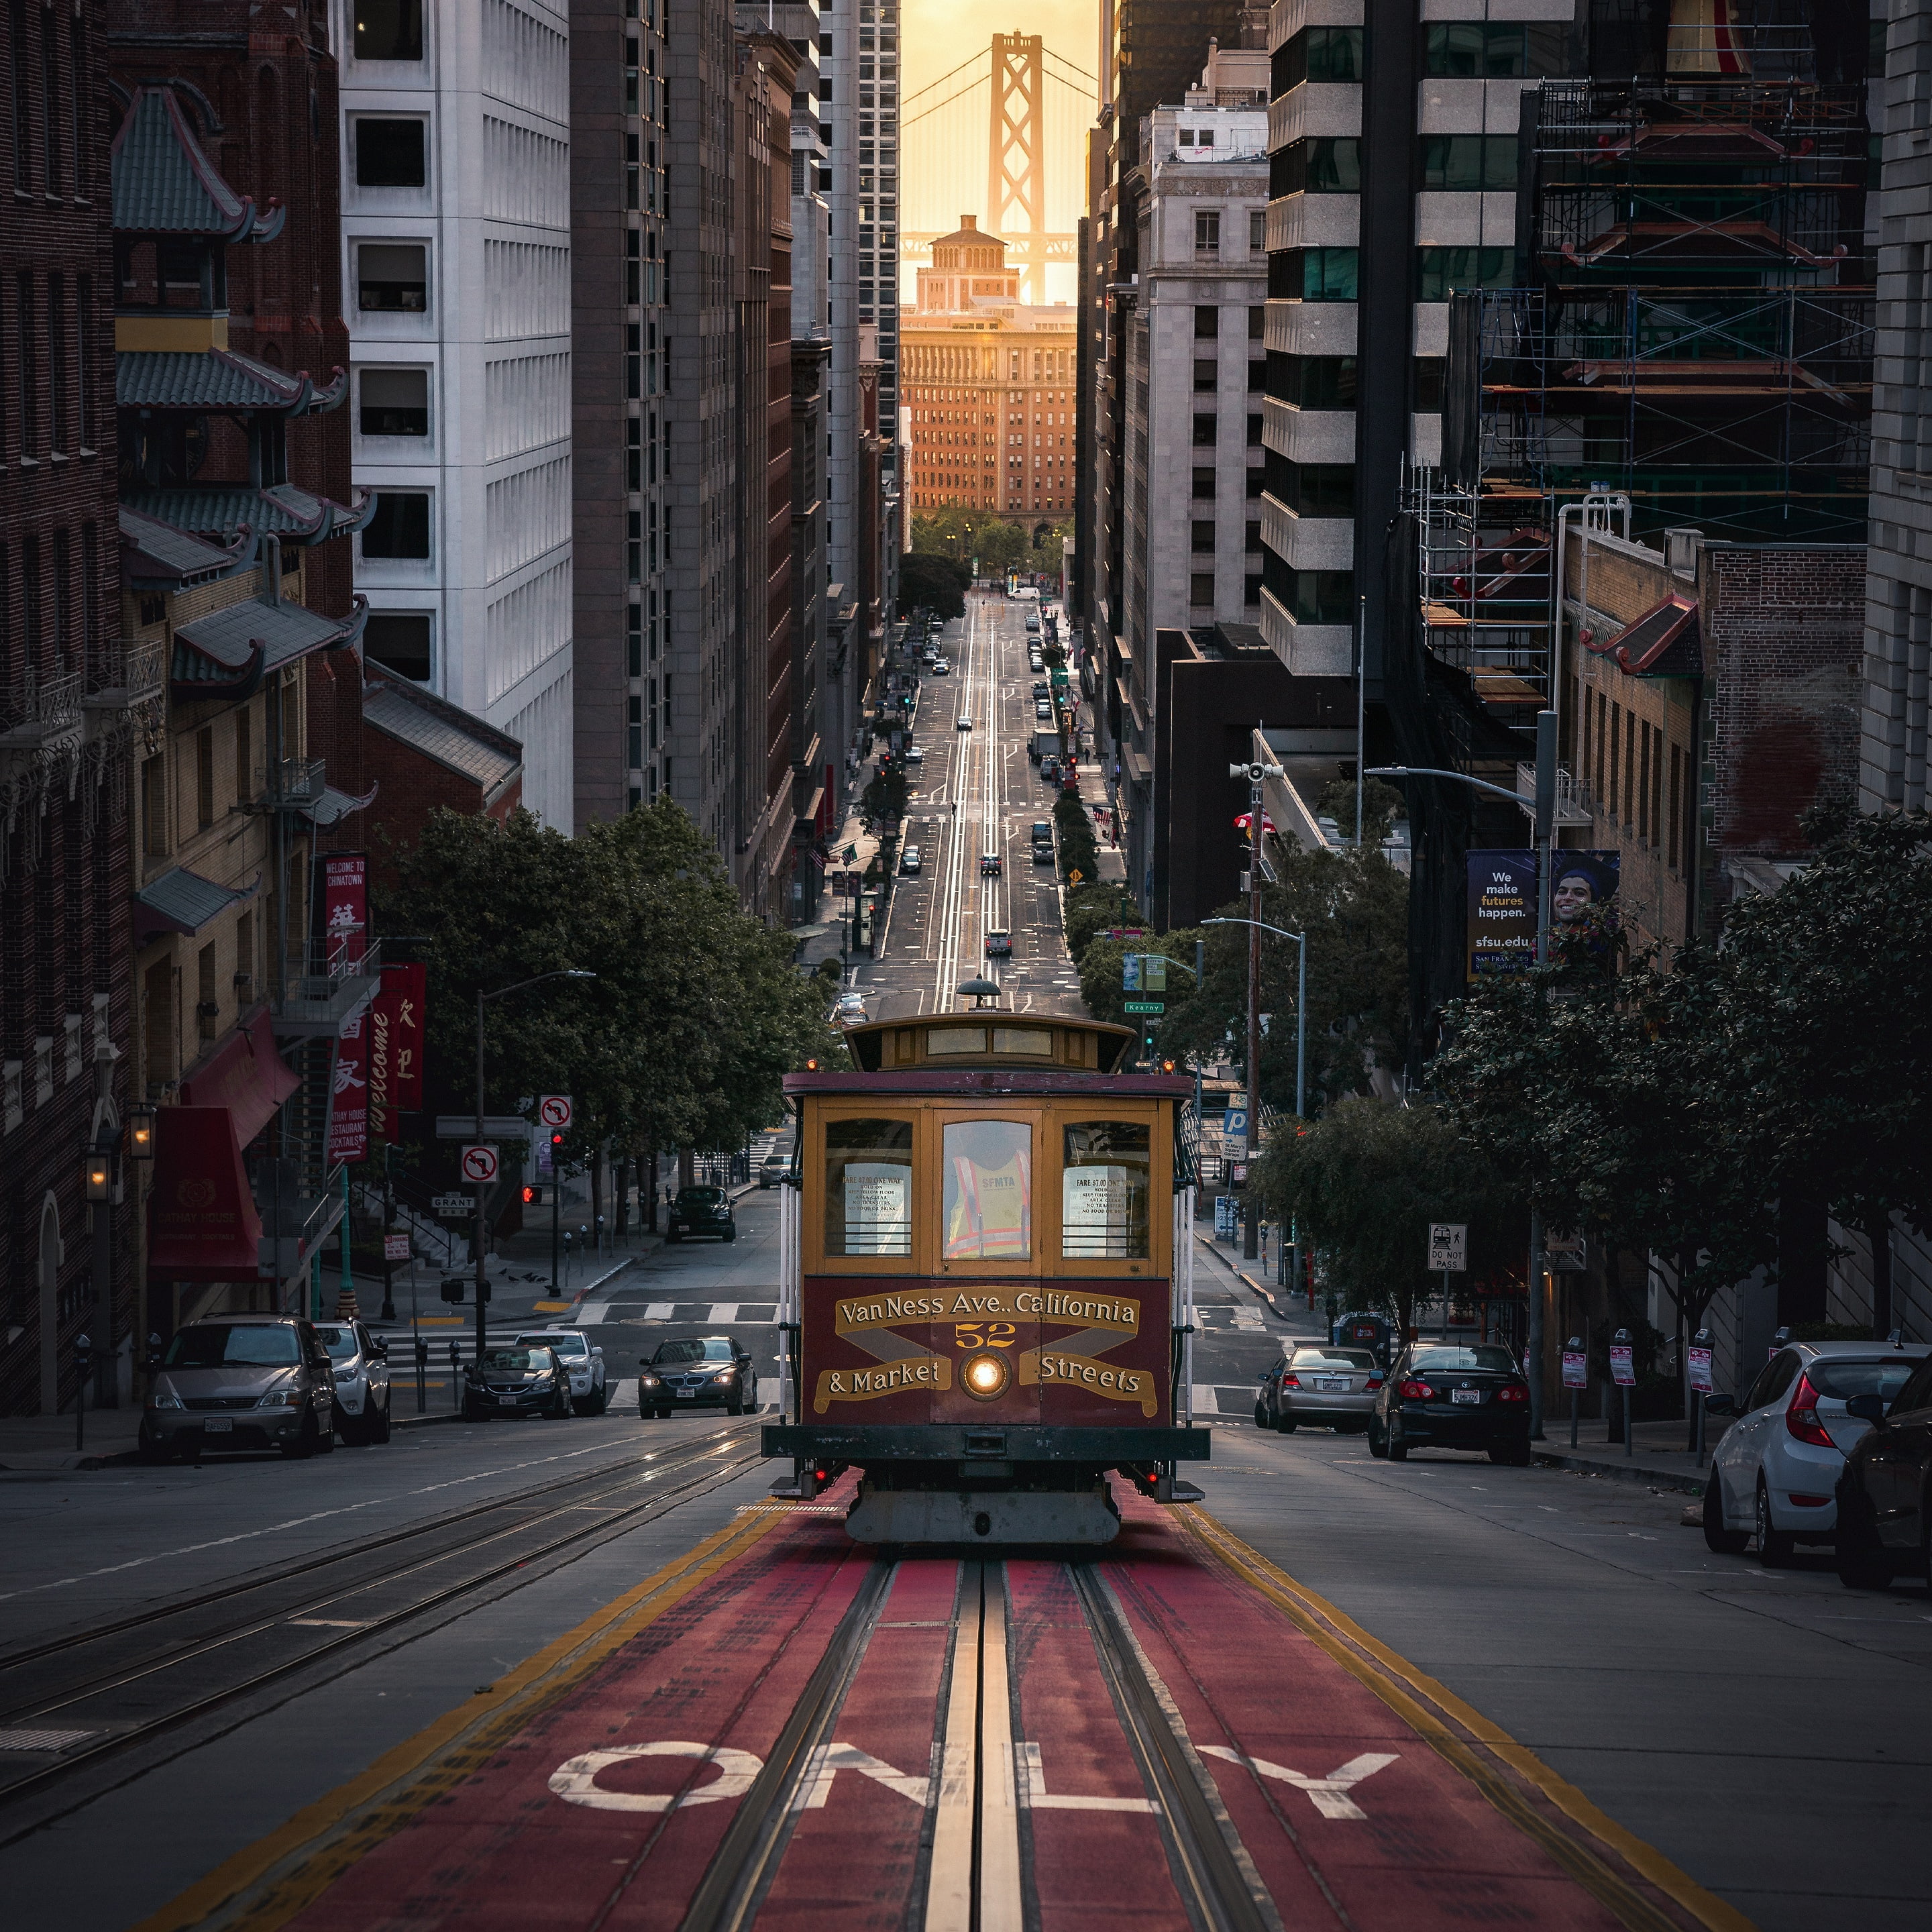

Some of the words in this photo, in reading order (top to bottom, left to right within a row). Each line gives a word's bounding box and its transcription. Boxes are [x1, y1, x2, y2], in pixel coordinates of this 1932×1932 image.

[326, 861, 354, 873] WELCOME
[356, 861, 364, 871] TO
[328, 874, 362, 886] CHINATOWN
[1493, 872, 1511, 882] We
[1487, 883, 1518, 894] make
[1481, 896, 1523, 906] futures
[1479, 907, 1526, 920] happen.
[1476, 936, 1529, 947] sfsu.edu
[332, 1110, 347, 1122] ATHAY
[349, 1109, 367, 1120] HOUSE
[331, 1122, 366, 1135] ESTAURANT
[982, 1175, 1015, 1188] SFMTA
[1437, 1260, 1457, 1269] PASS
[1015, 1293, 1135, 1324] California
[955, 1323, 1016, 1348] 52
[829, 1373, 847, 1393] &
[850, 1362, 939, 1393] Market
[1039, 1357, 1141, 1393] Streets
[547, 1741, 1400, 1819] ONLY
